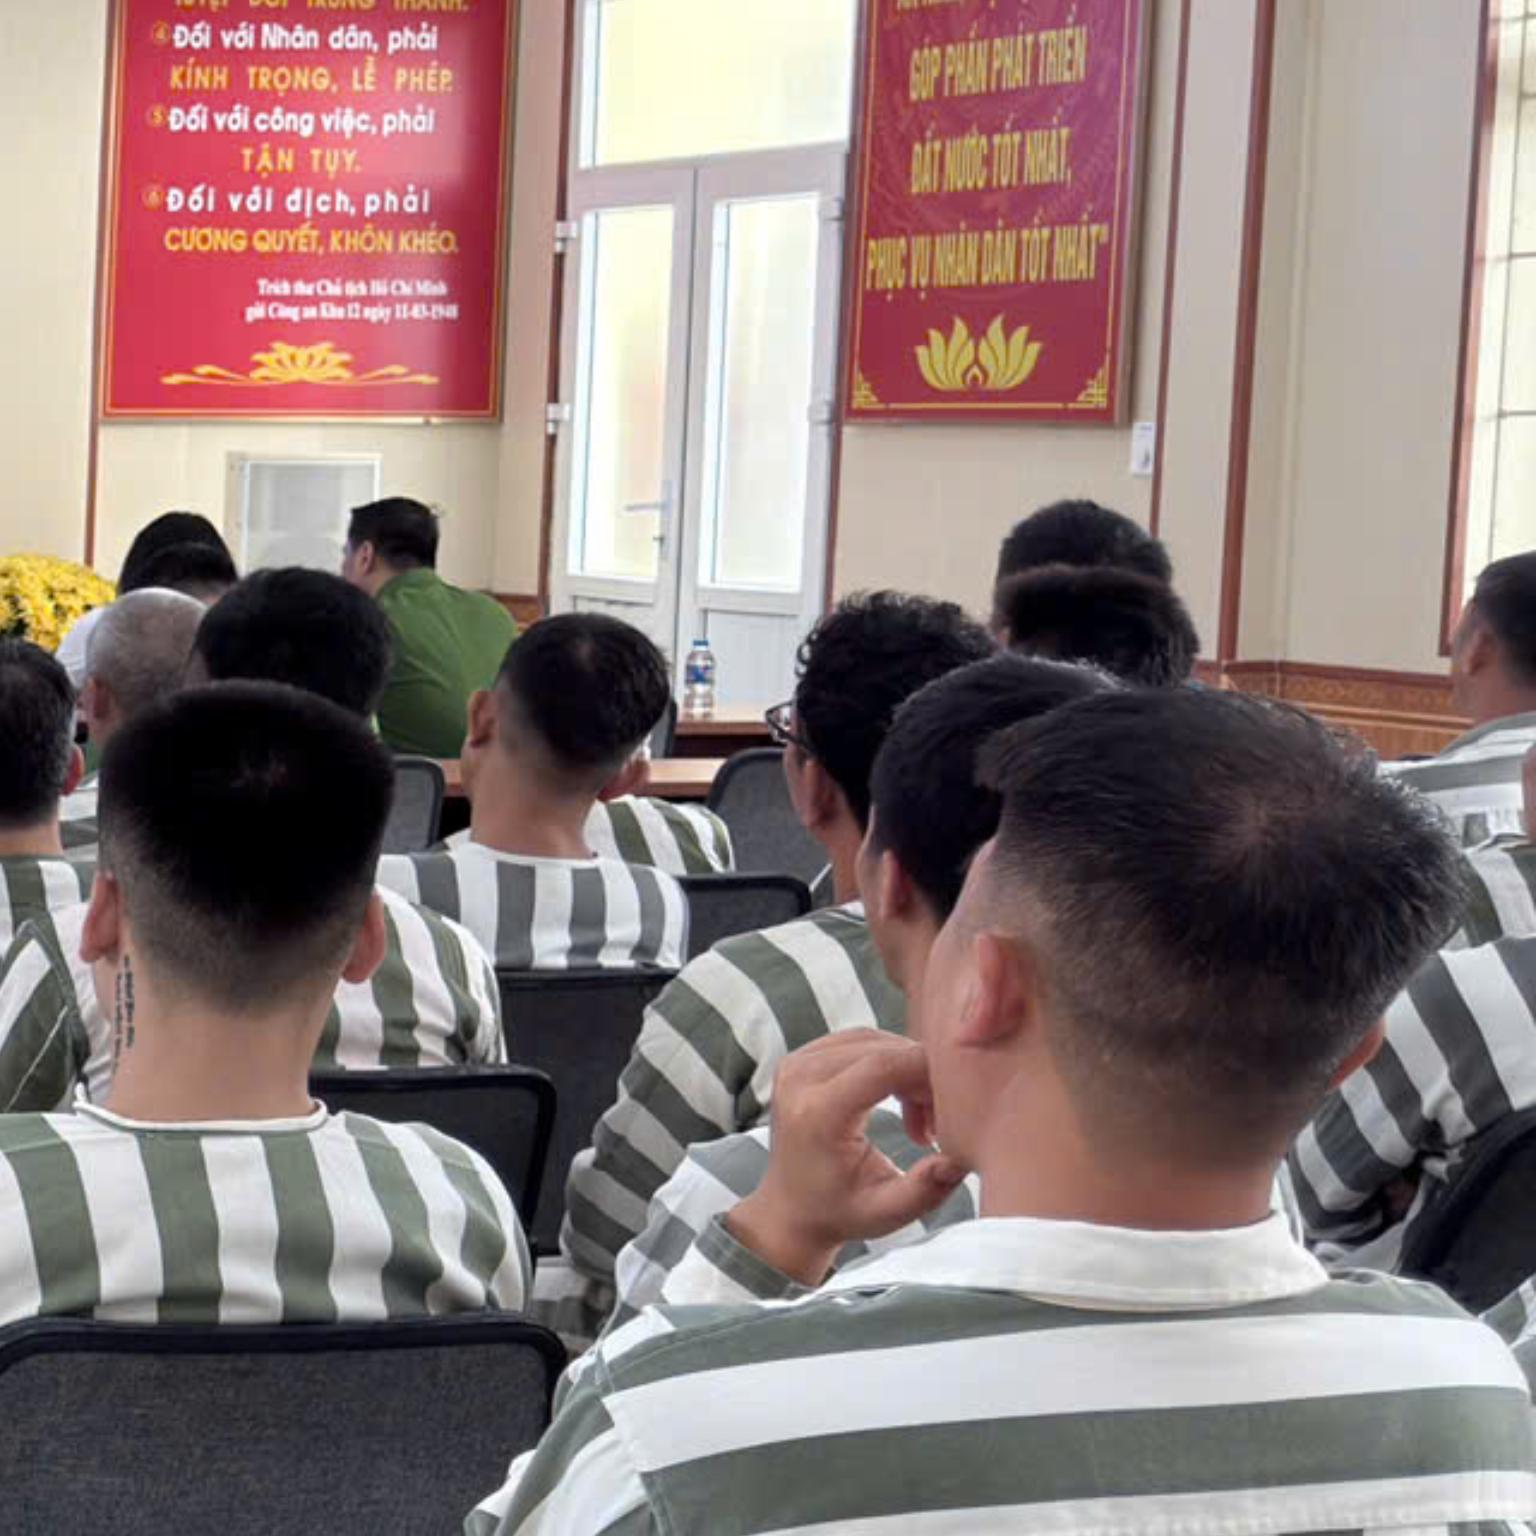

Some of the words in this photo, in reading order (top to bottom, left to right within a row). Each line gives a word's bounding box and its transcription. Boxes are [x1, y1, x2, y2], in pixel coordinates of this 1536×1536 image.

[173, 23, 211, 49] Đối
[220, 23, 254, 49] với
[262, 23, 318, 49] Nhân
[329, 25, 378, 53] dân,
[387, 23, 438, 56] phải
[171, 58, 228, 89] KÍNH
[248, 67, 337, 96] TRỌNG,
[352, 55, 376, 91] LỄ
